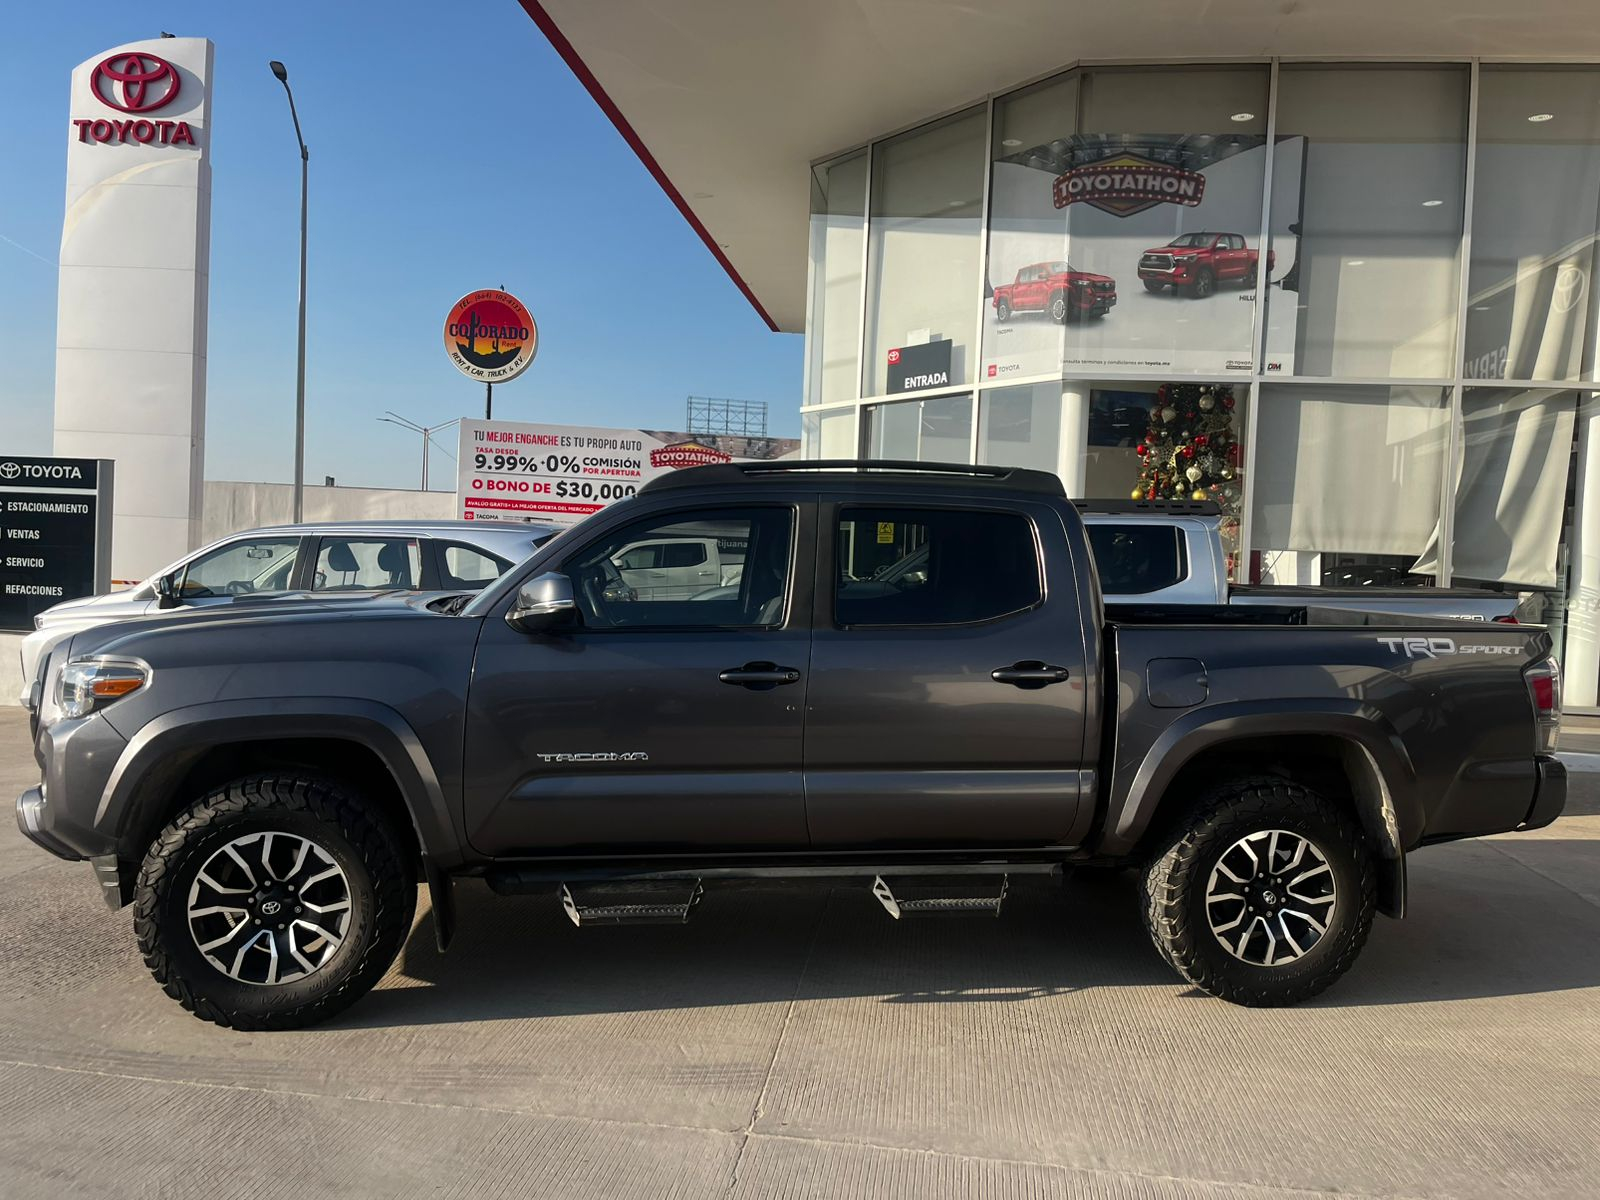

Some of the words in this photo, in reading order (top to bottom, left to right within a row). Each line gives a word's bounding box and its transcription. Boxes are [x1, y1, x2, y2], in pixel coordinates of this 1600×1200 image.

[73, 119, 195, 145] TOYOTA
[1059, 174, 1196, 197] TOYOTATHON
[449, 322, 529, 341] COLORADO
[487, 369, 508, 378] TRUCK
[998, 364, 1020, 373] TOYOTA
[904, 371, 948, 389] ENTRADA
[474, 430, 485, 441] TU
[486, 431, 514, 443] MEJOR
[515, 433, 559, 446] ENGANCHE
[560, 436, 571, 447] ES
[574, 437, 585, 448] TU
[587, 438, 618, 450] PROPIO
[619, 440, 642, 451] AUTO
[474, 453, 538, 473] 9.99%
[582, 456, 641, 469] COMISIÓN
[22, 465, 82, 479] TOYOTA
[582, 467, 599, 475] POR
[600, 469, 641, 477] APERTURA
[472, 479, 483, 490] O
[486, 479, 529, 492] BONO
[532, 482, 551, 494] DE
[556, 480, 637, 502] $30,000
[7, 501, 89, 514] ESTACIONAMIENTO
[7, 529, 40, 540] VENTAS
[718, 540, 748, 549] tijuana
[6, 557, 45, 568] SERVICIO
[5, 584, 63, 596] REFACCIONES
[1377, 637, 1457, 660] TRD
[1458, 645, 1525, 655] SPORT
[537, 751, 649, 762] TACOMA
